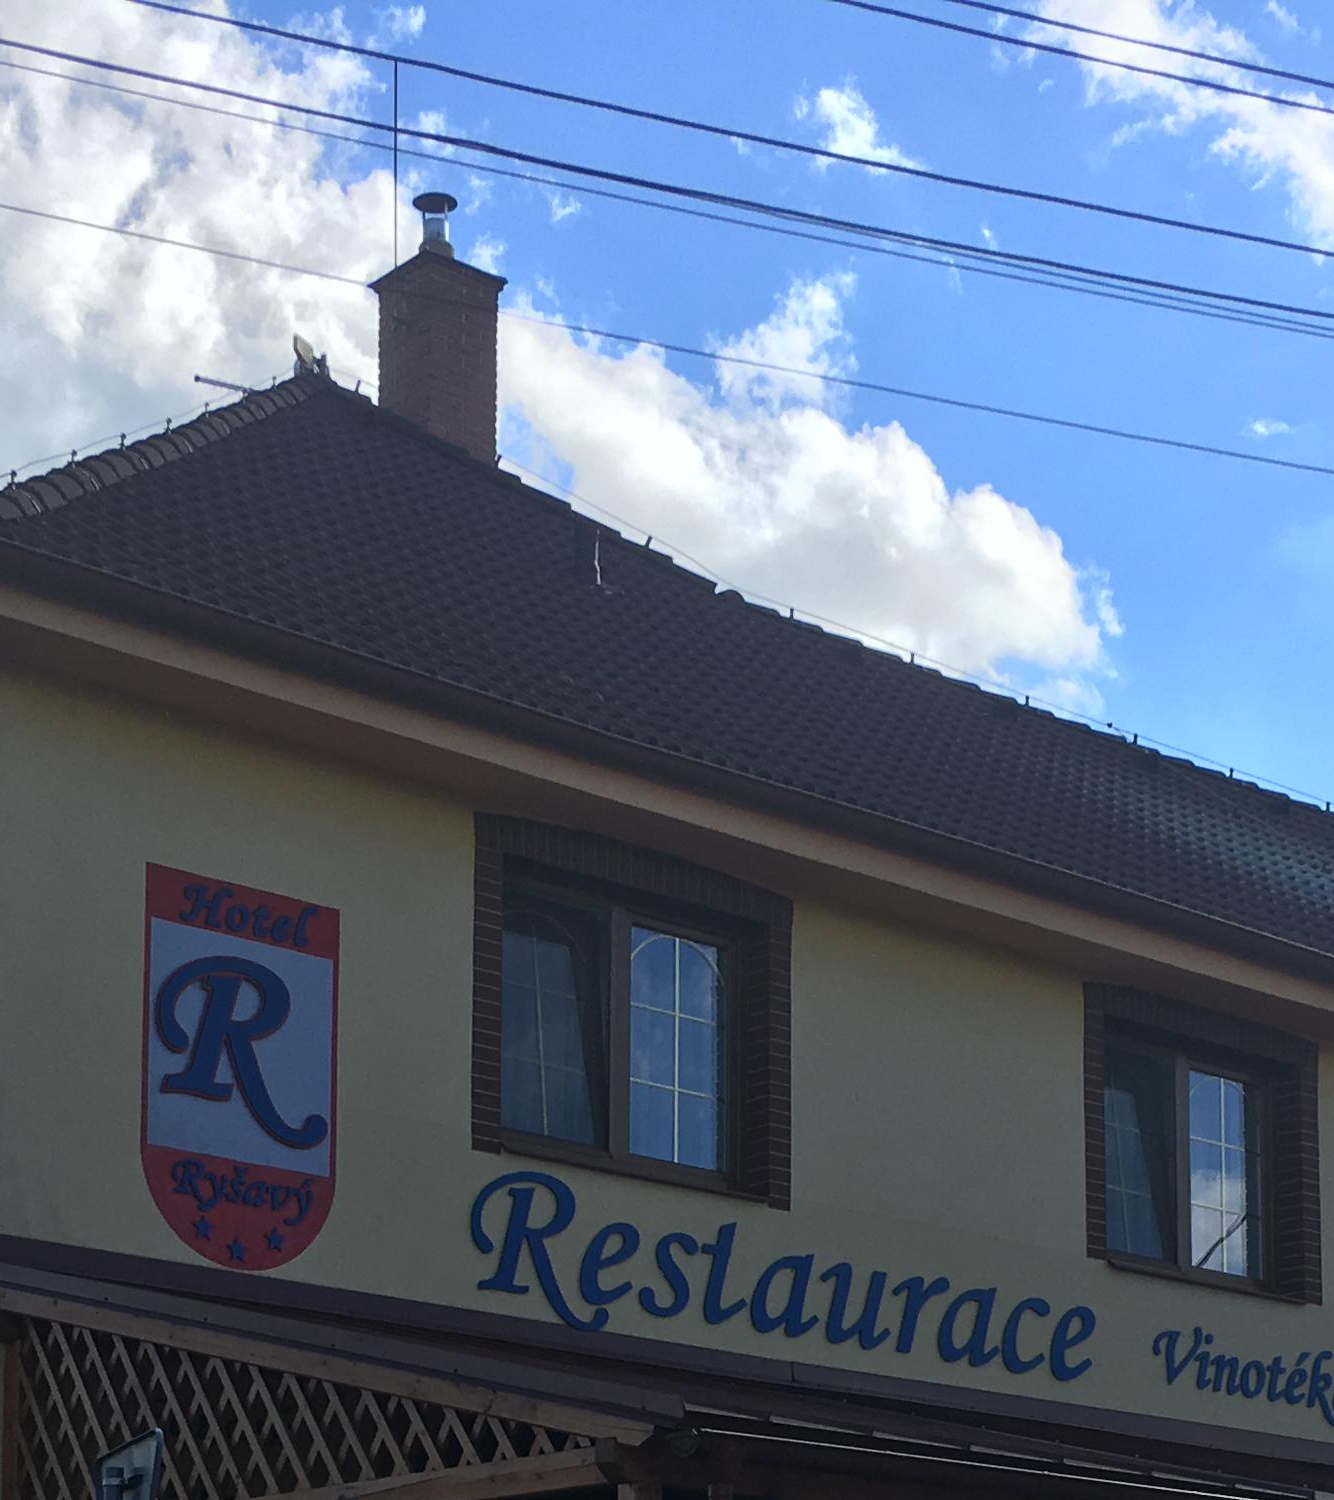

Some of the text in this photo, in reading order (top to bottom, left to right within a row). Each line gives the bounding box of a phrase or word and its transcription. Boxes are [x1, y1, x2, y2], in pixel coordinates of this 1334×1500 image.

[179, 882, 321, 949] Hotel
[154, 954, 329, 1150] R
[170, 1157, 315, 1228] Ryšavý
[470, 1170, 1099, 1382] Restaurace
